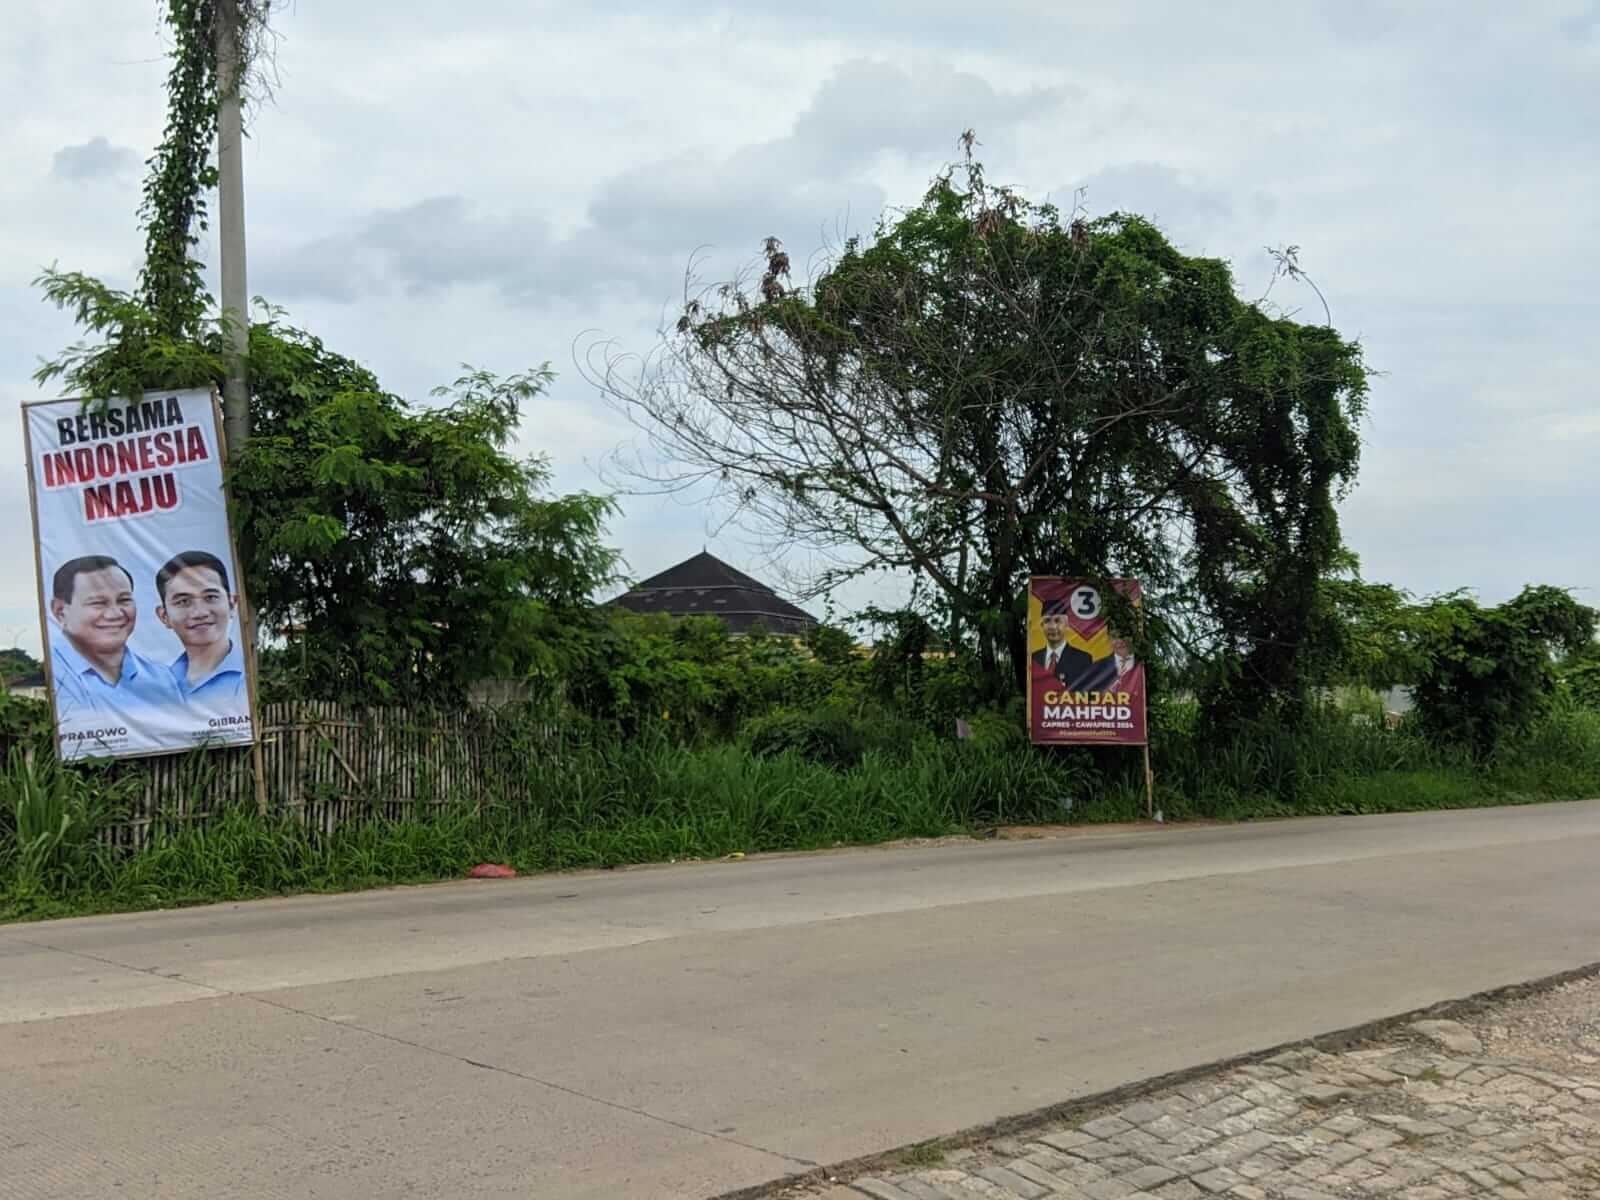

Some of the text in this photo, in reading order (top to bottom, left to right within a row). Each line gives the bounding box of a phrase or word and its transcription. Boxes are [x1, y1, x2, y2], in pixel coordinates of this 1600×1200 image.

[57, 398, 184, 446] BERSAMA
[43, 427, 208, 487] INDONESIA
[84, 473, 178, 521] MAJU
[1078, 592, 1095, 615] 3
[1044, 691, 1130, 705] GANJAR
[1044, 706, 1131, 720] MAHFUD
[59, 727, 127, 742] PRABOWO
